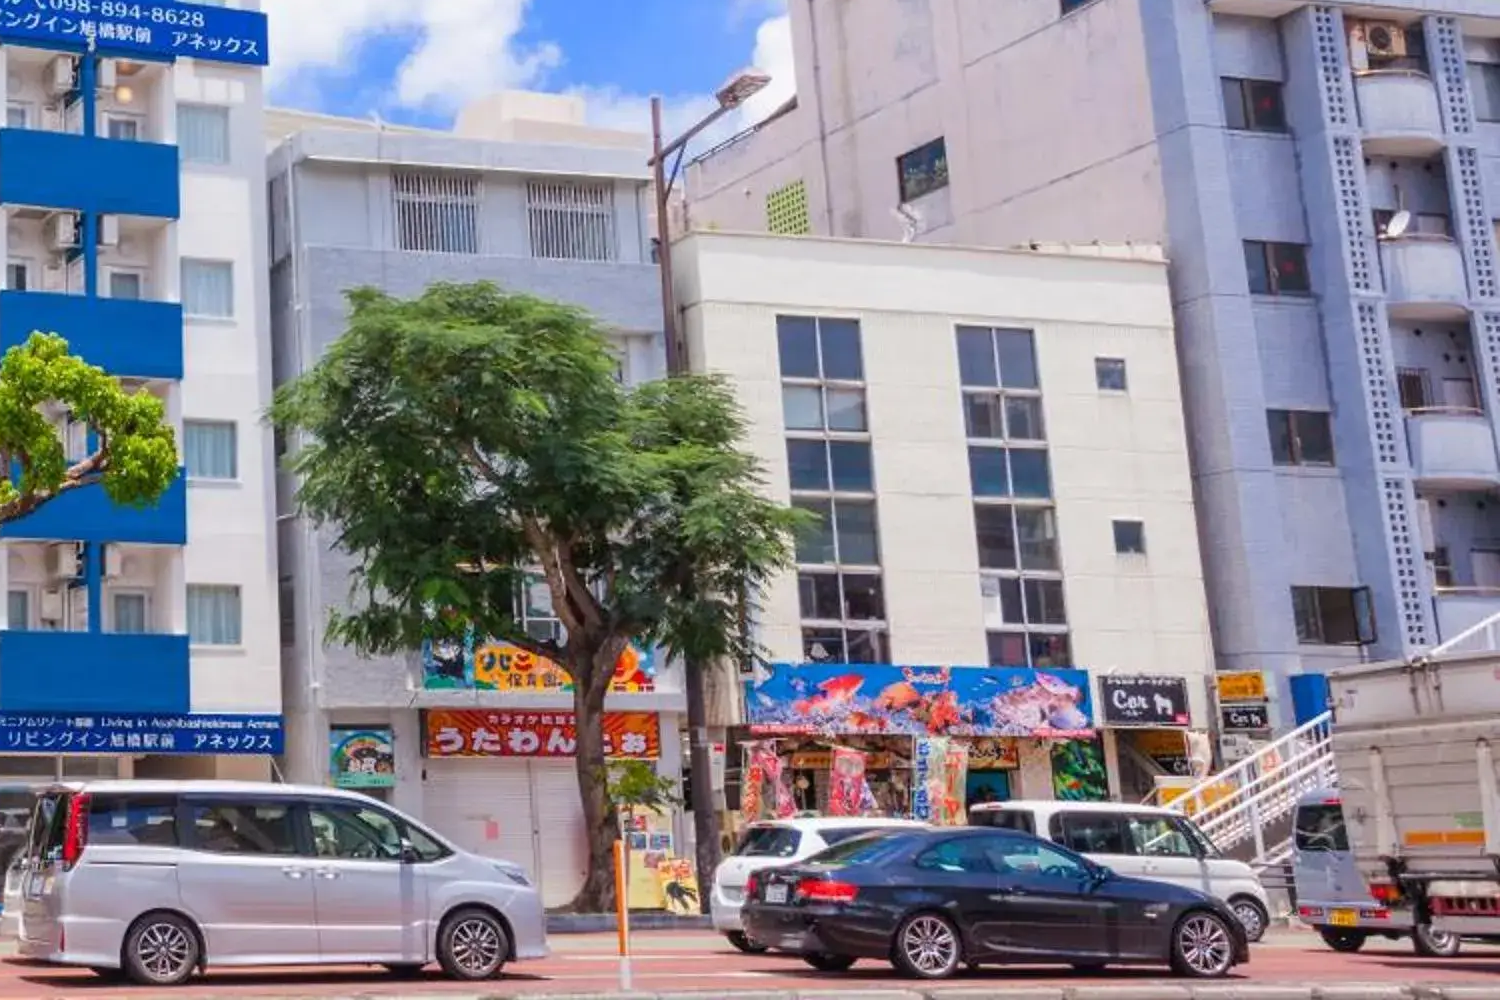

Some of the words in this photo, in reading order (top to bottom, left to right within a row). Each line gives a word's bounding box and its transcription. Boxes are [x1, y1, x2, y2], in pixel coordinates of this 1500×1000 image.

[171, 31, 260, 57] アネックス
[194, 733, 273, 750] アネックス
